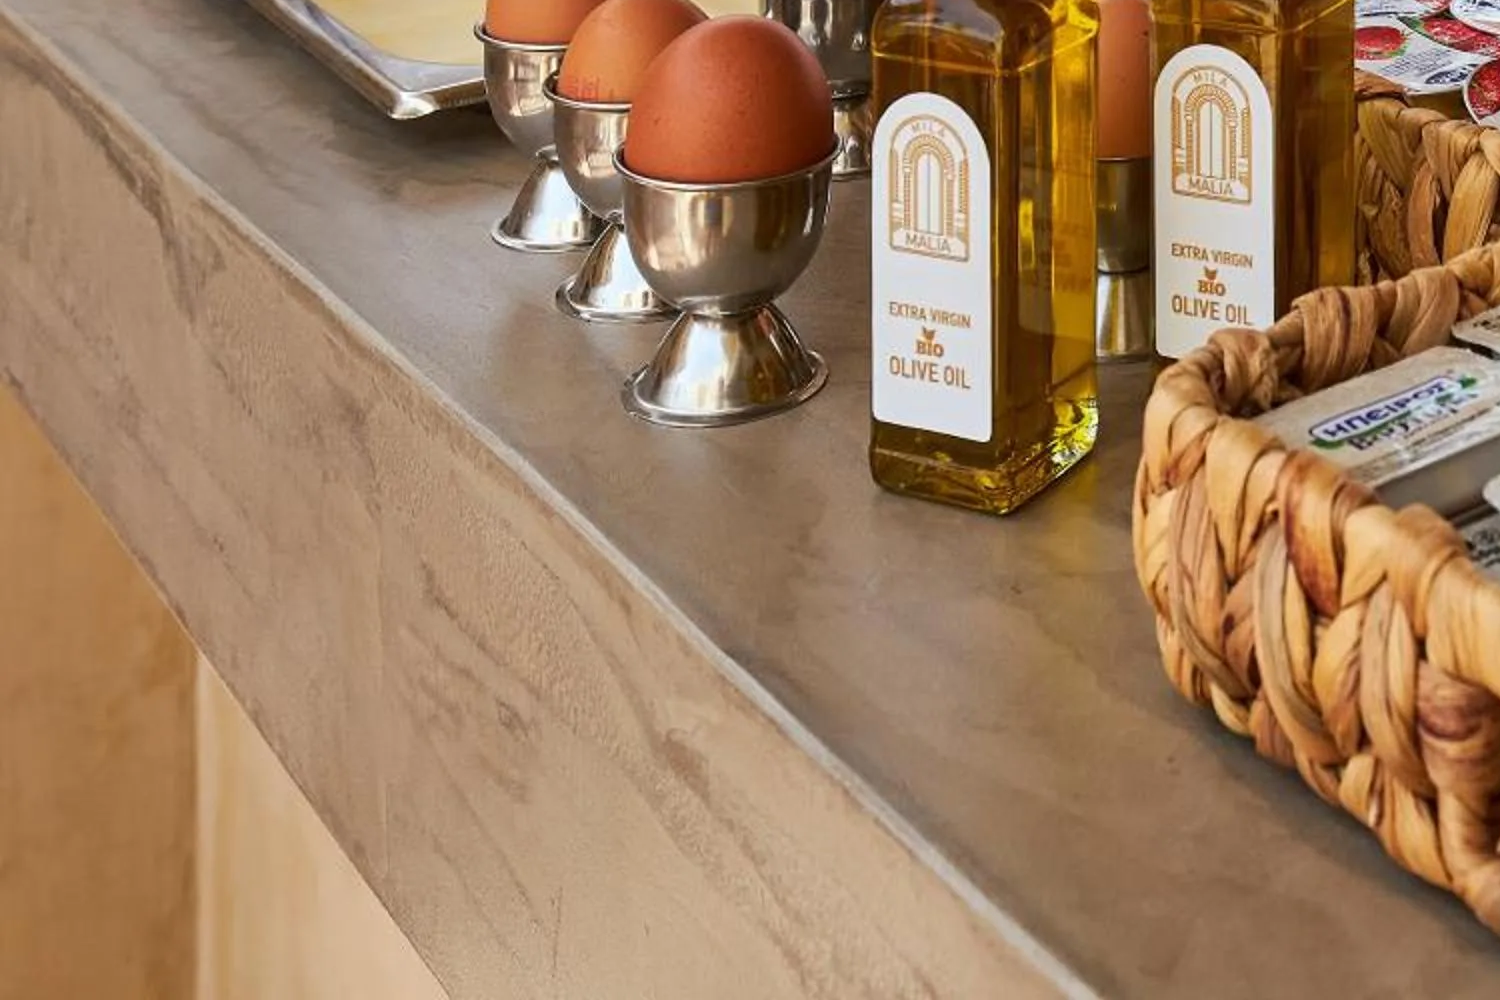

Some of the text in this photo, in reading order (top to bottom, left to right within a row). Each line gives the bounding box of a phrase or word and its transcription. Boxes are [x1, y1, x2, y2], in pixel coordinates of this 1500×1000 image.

[1192, 72, 1229, 88] MILA
[910, 121, 946, 138] MILA
[1187, 176, 1236, 197] MALIA
[904, 232, 952, 252] MALIA
[1171, 243, 1254, 269] EXTRA VIRGIN
[1197, 278, 1227, 297] BIO
[888, 301, 972, 329] EXTRA VIRGIN
[1171, 295, 1253, 326] OLIVE OIL
[914, 340, 945, 358] BIO
[888, 355, 971, 389] OLIVE OIL
